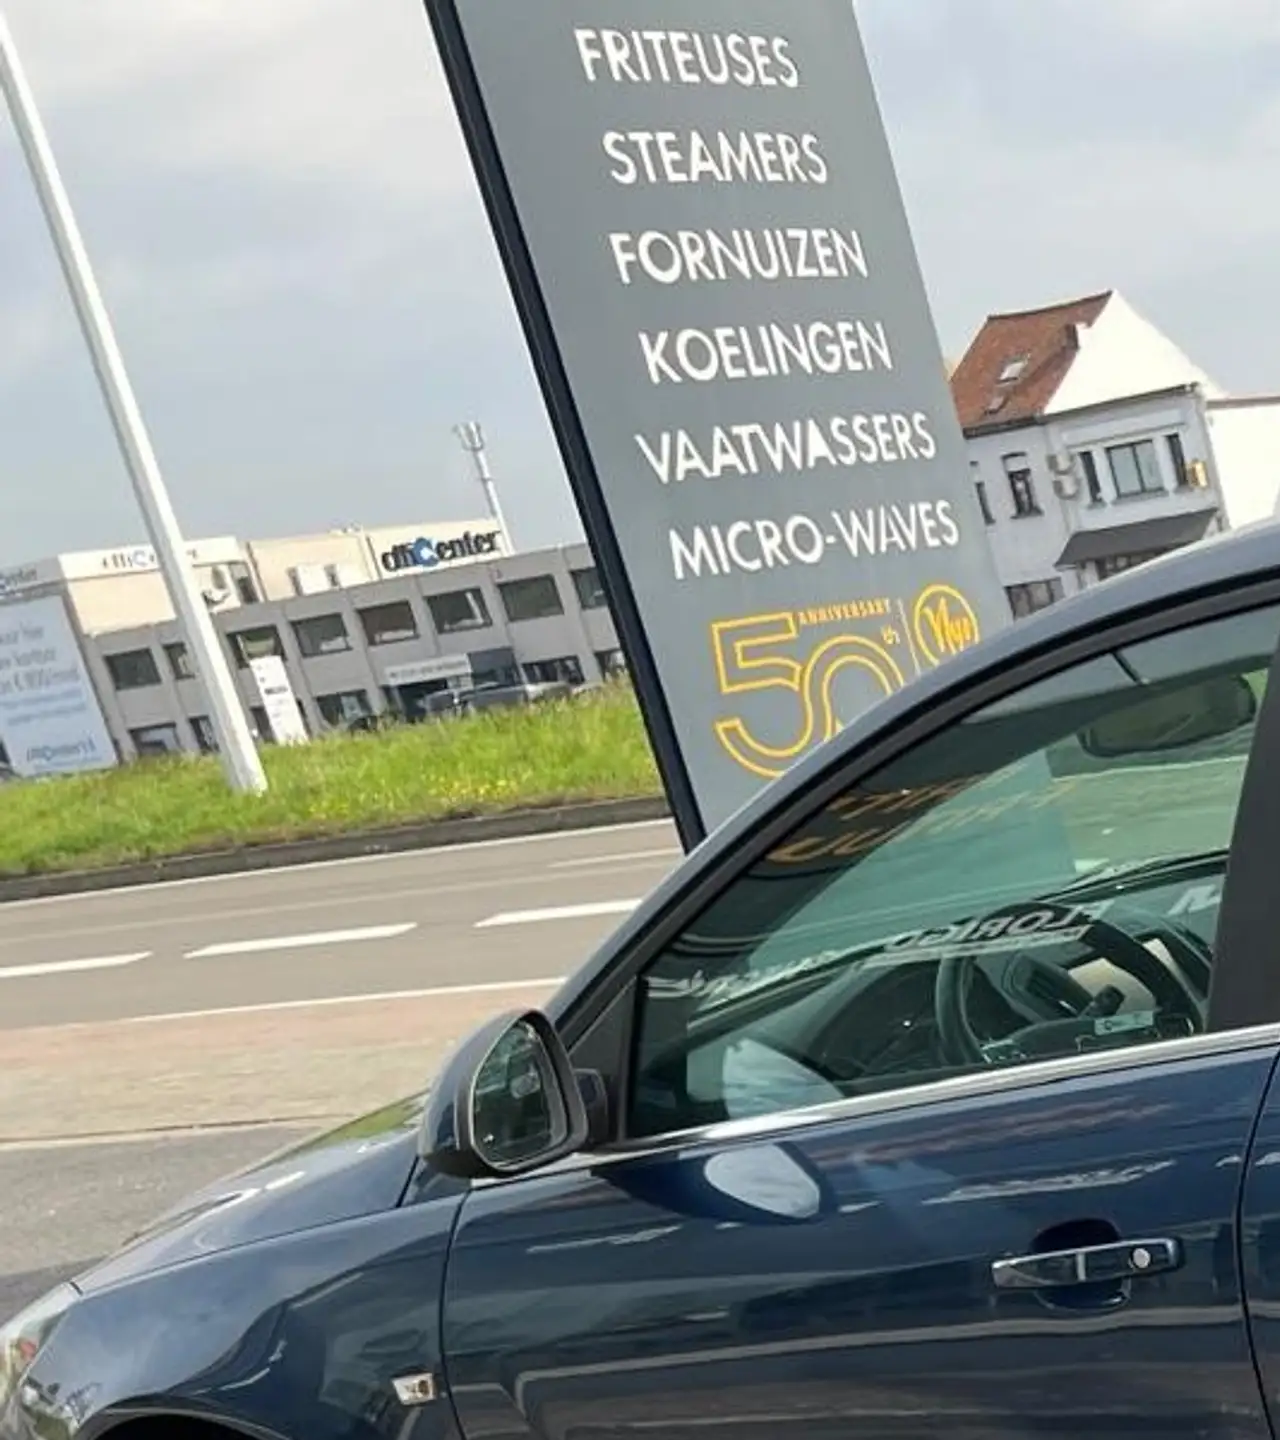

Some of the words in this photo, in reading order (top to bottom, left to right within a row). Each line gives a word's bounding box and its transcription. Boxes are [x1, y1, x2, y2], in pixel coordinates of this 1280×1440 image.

[574, 28, 799, 88] FRITEUSES
[602, 131, 828, 184] STEAMERS
[608, 228, 869, 285] FORNUIZEN
[638, 321, 893, 384] KOELINGEN
[634, 412, 937, 484] VAATWASSERS
[668, 499, 959, 580] MICRO-WAVES
